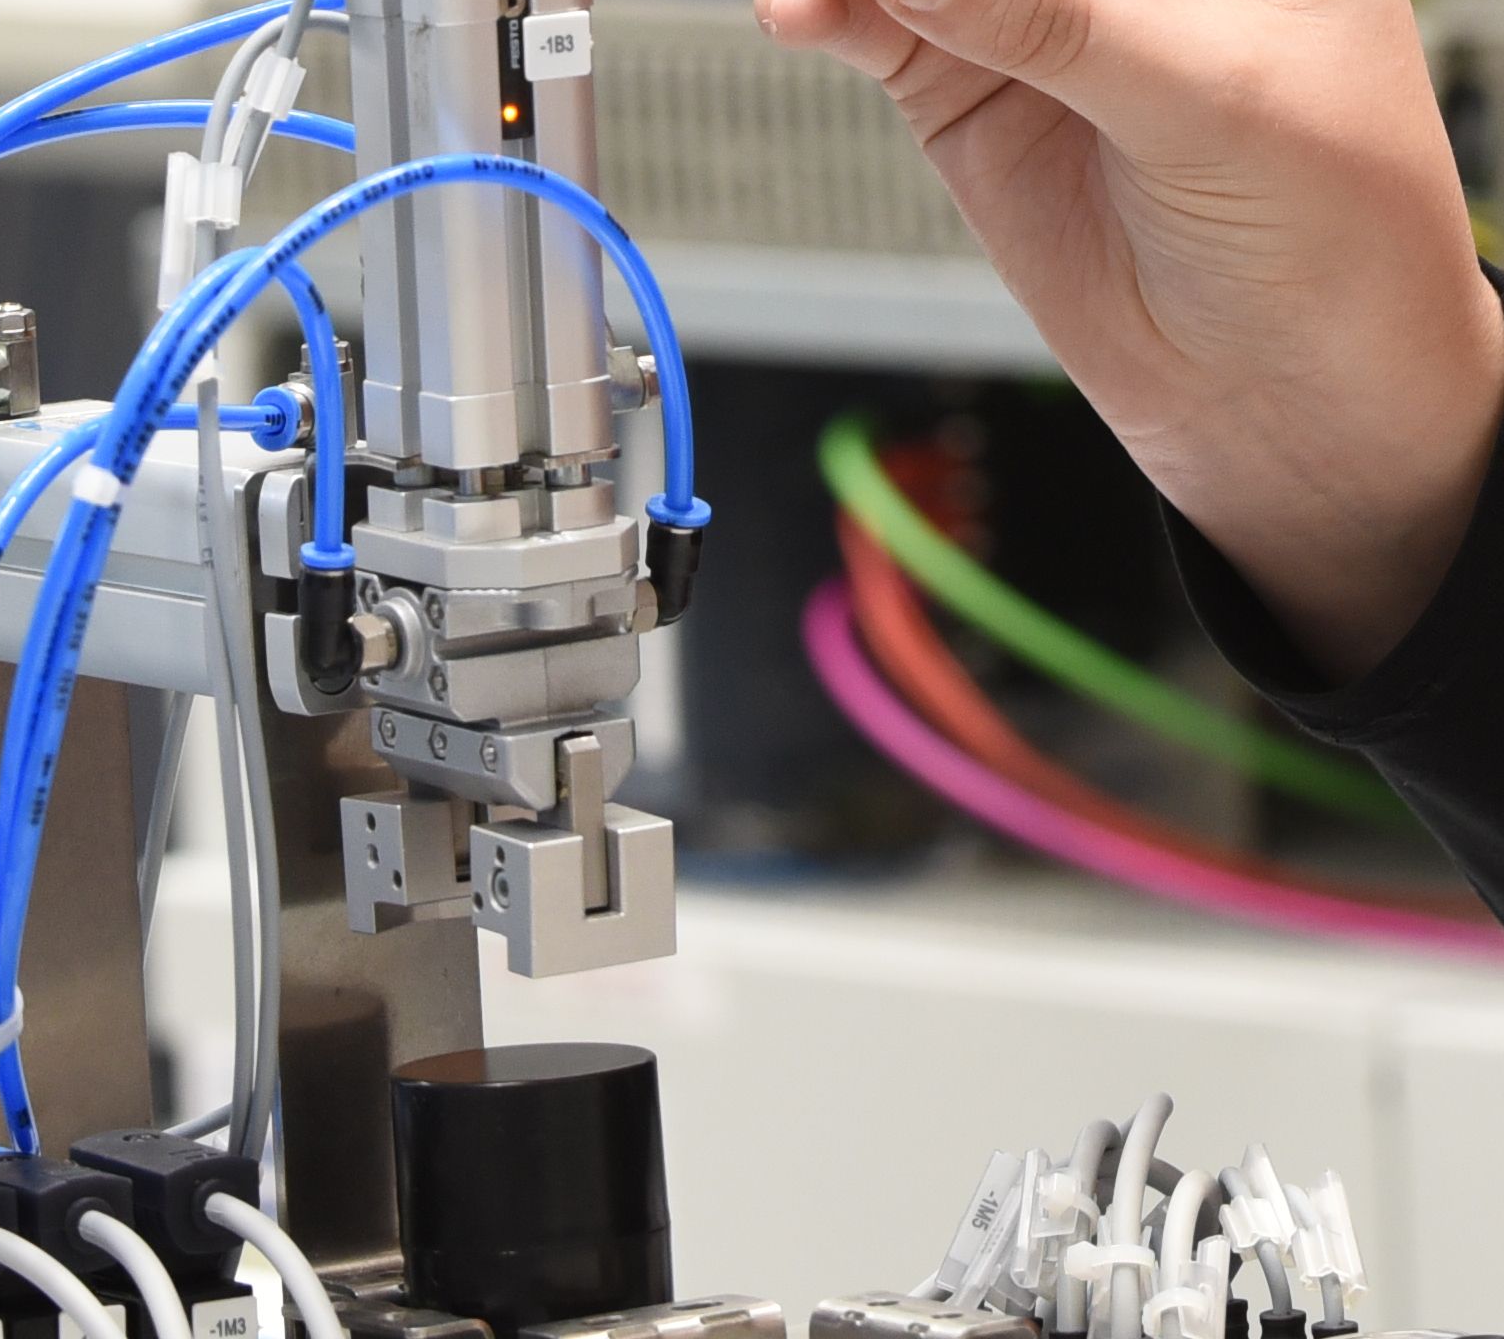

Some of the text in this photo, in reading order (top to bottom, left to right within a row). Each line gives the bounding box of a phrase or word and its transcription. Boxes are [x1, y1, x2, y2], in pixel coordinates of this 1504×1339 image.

[508, 19, 521, 70] FESTO
[539, 33, 575, 55] -1B3
[971, 1190, 999, 1232] -1M5
[209, 1316, 247, 1338] -1M3
